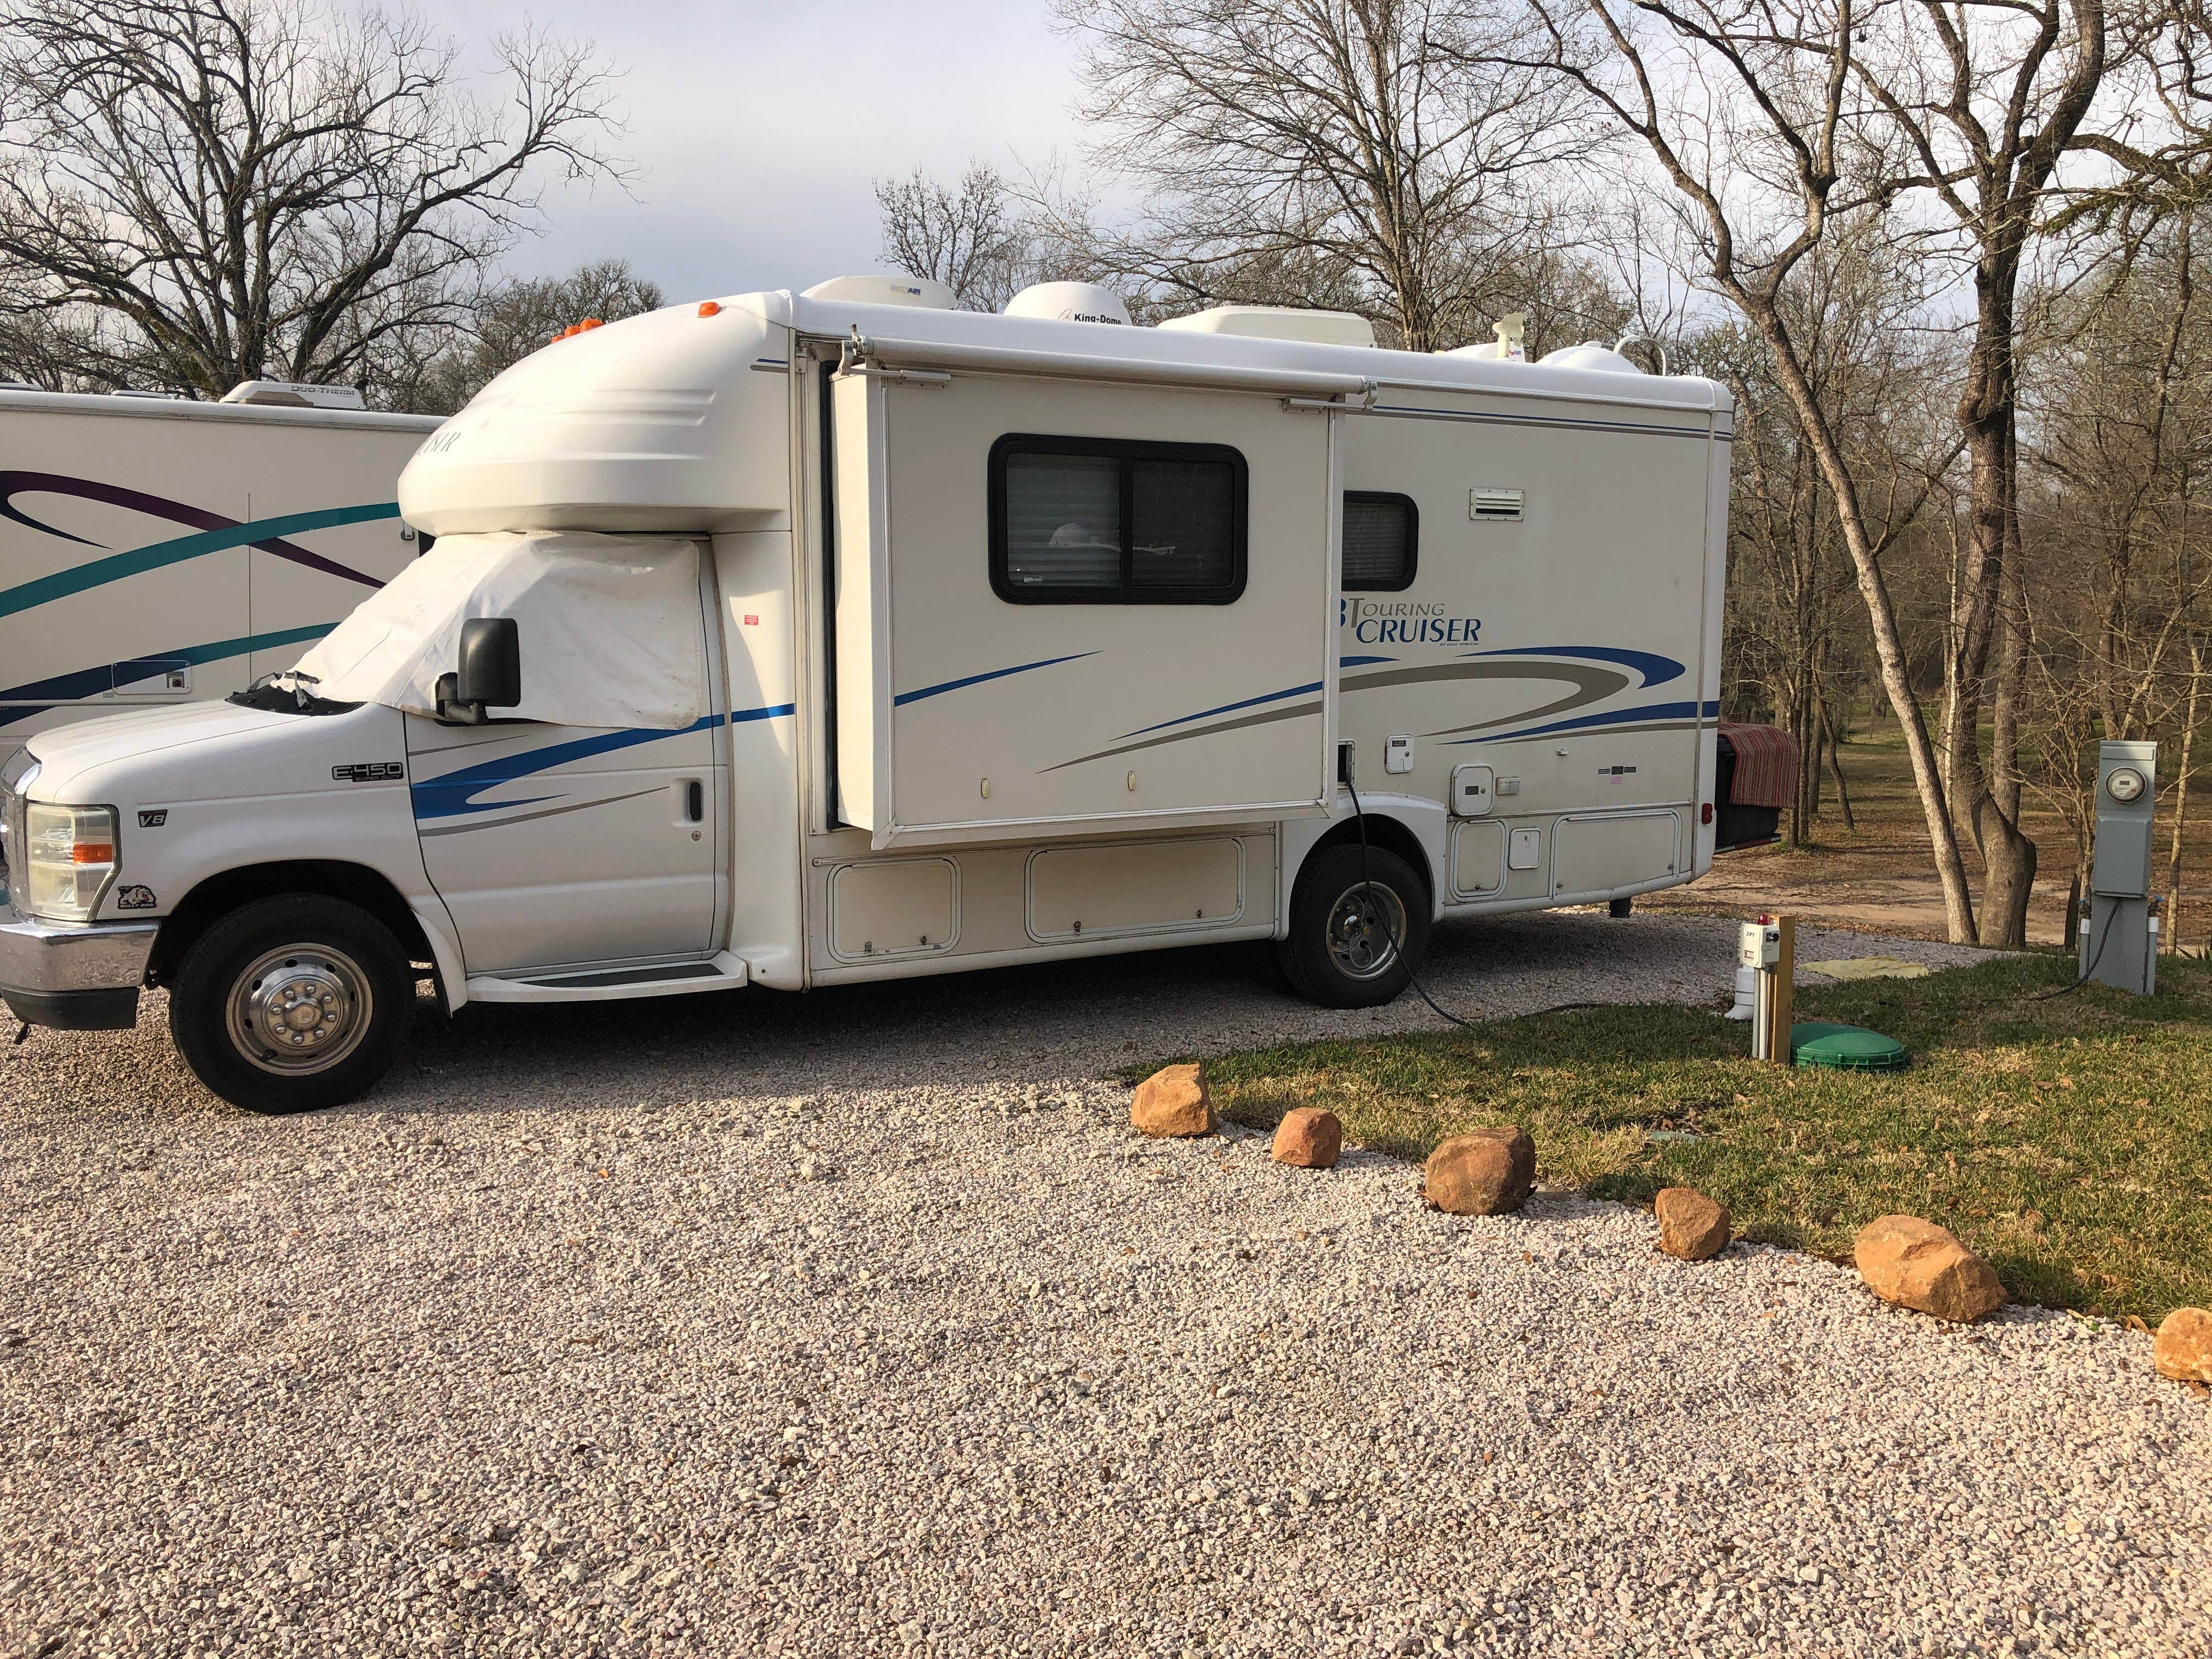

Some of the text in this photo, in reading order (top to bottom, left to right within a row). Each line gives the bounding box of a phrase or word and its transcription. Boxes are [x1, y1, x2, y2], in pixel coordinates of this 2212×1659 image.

[291, 386, 354, 395] DUO-THERM
[1356, 618, 1482, 644] CRUISER
[139, 815, 165, 827] V8
